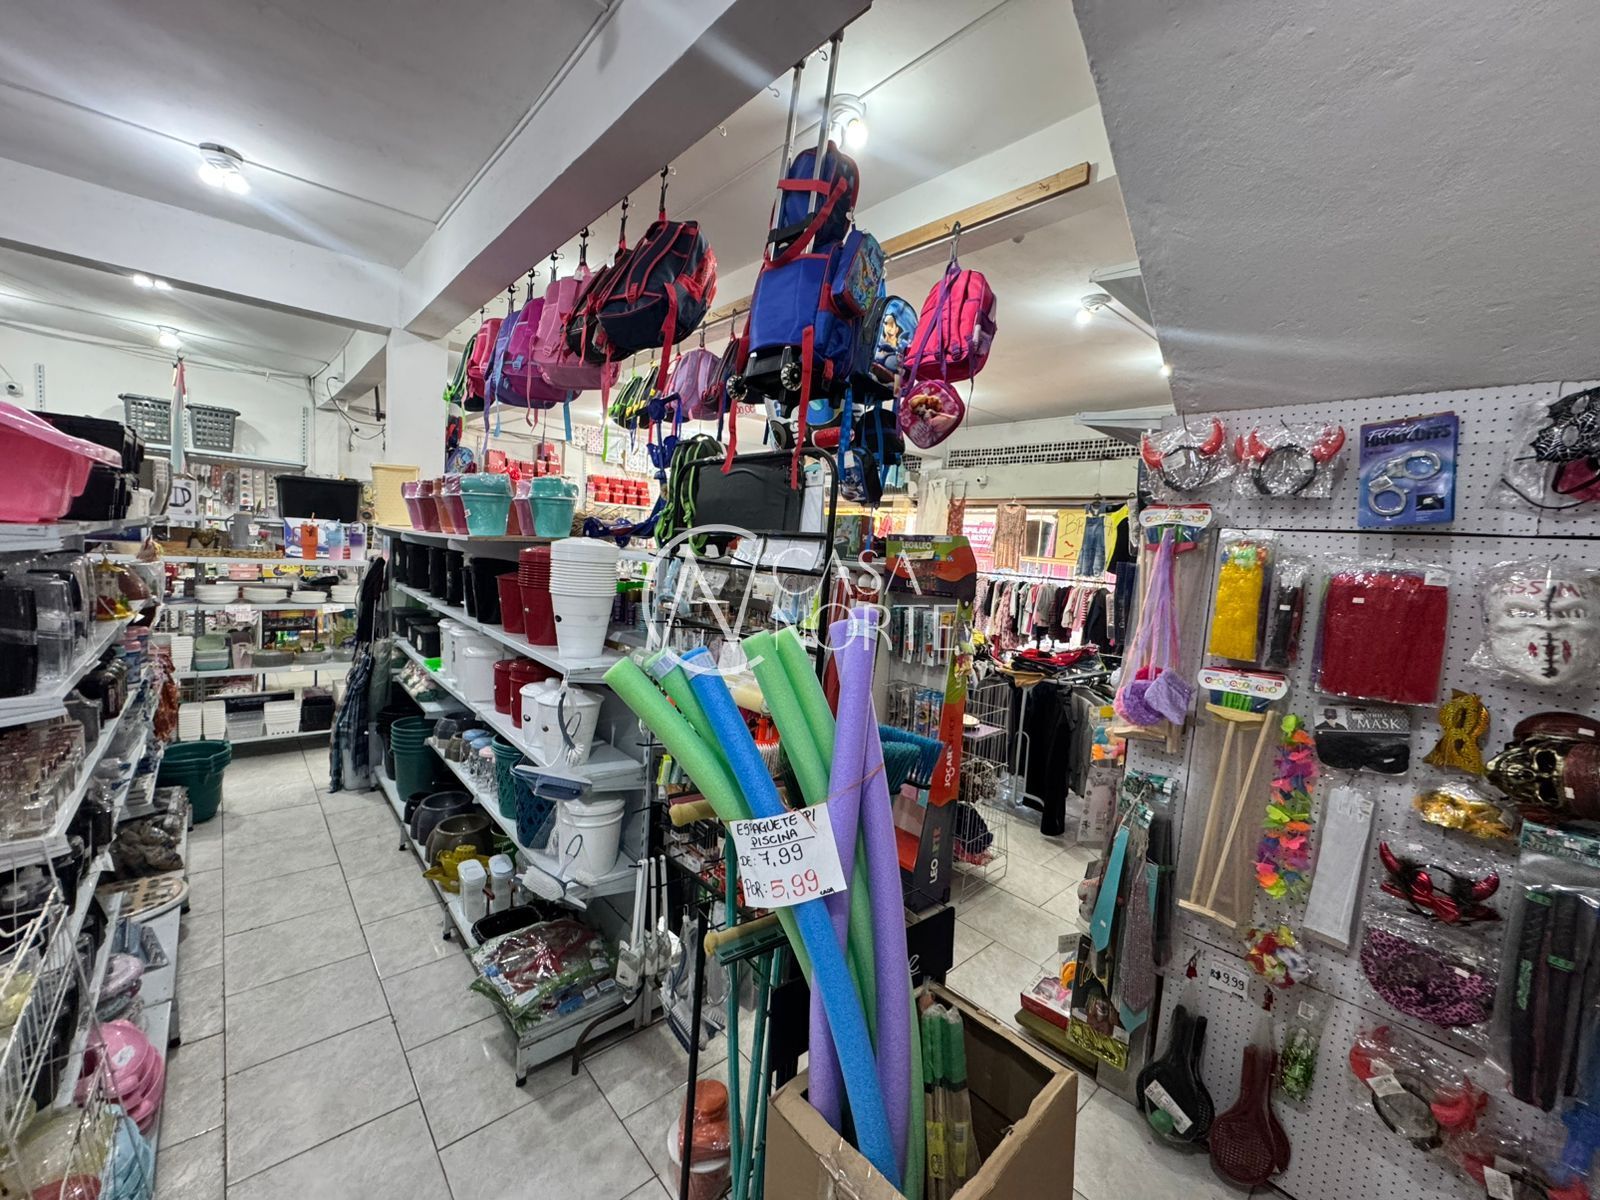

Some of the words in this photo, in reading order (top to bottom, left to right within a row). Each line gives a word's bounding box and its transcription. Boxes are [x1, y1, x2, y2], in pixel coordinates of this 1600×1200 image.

[1357, 719, 1401, 730] MASK
[751, 828, 798, 847] PISCINA
[929, 858, 938, 884] LEO
